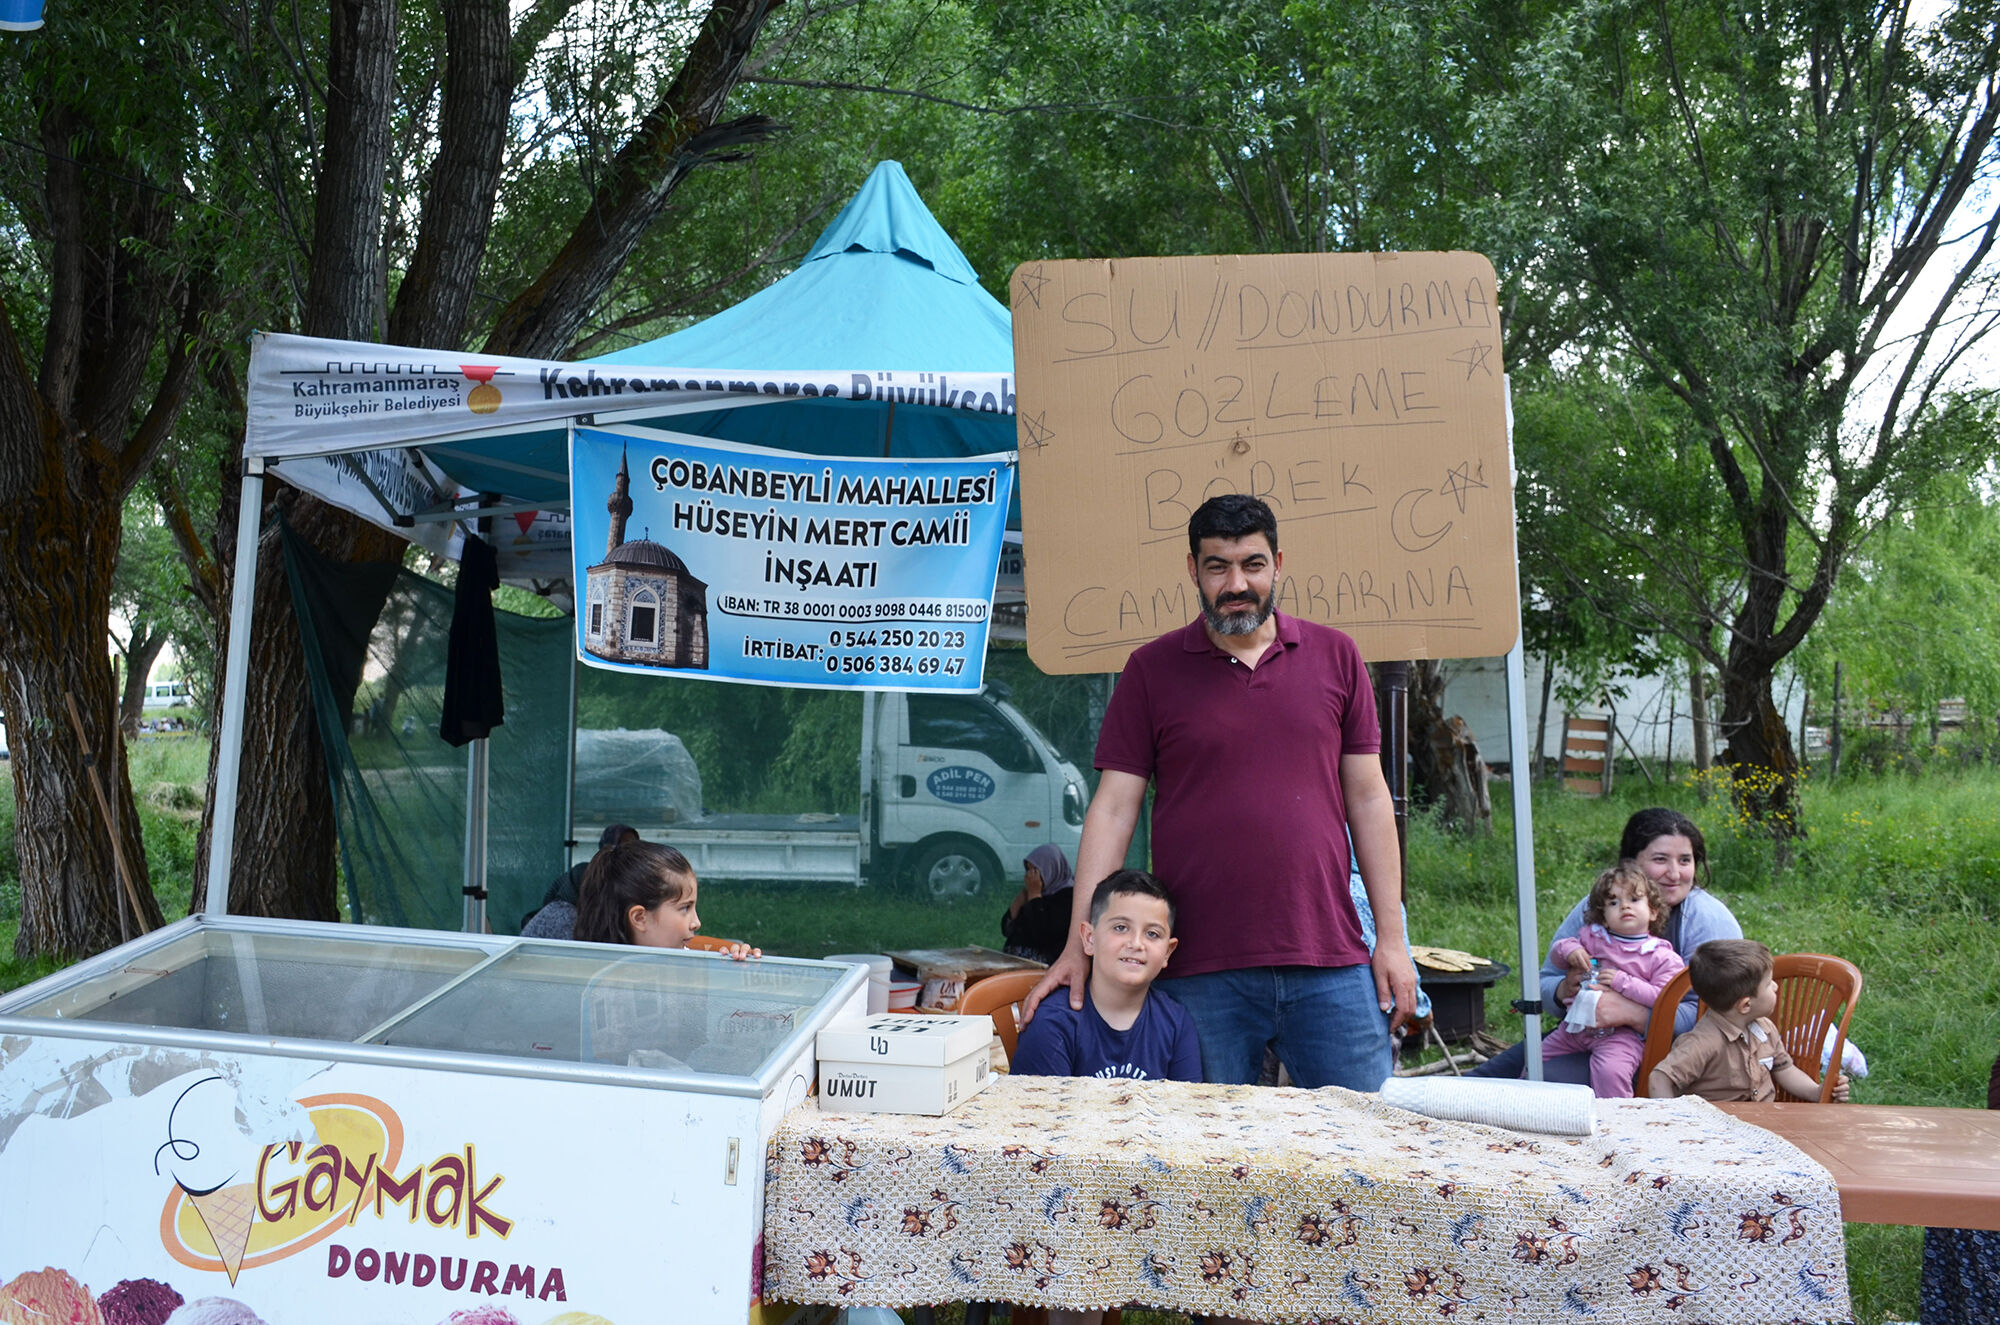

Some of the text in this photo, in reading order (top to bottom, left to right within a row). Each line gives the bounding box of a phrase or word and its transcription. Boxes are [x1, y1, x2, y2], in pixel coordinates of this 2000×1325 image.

[1062, 288, 1181, 354] SU
[1235, 276, 1493, 343] DONDURMA
[292, 378, 461, 398] Kahramanmaraş
[1110, 363, 1440, 444] GÖZLEME
[294, 394, 461, 420] Büyükşehir Belediyesi
[651, 457, 996, 505] ÇOBANBEYLİ MAHALLESİ
[674, 499, 969, 547] HÜSEYİN MERT CAMİİ
[765, 550, 878, 592] İNŞAATI
[724, 595, 986, 618] İBAN: TR 38 0001 0003 9098 0446 815001
[1276, 565, 1473, 619] ARARINA
[743, 635, 824, 661] İRTİBAT:
[830, 630, 965, 649] 0 544 250 20 23
[827, 655, 965, 675] 0 506 384 69 47
[827, 1079, 878, 1098] UMUT
[327, 1244, 567, 1302] DONDURMA
